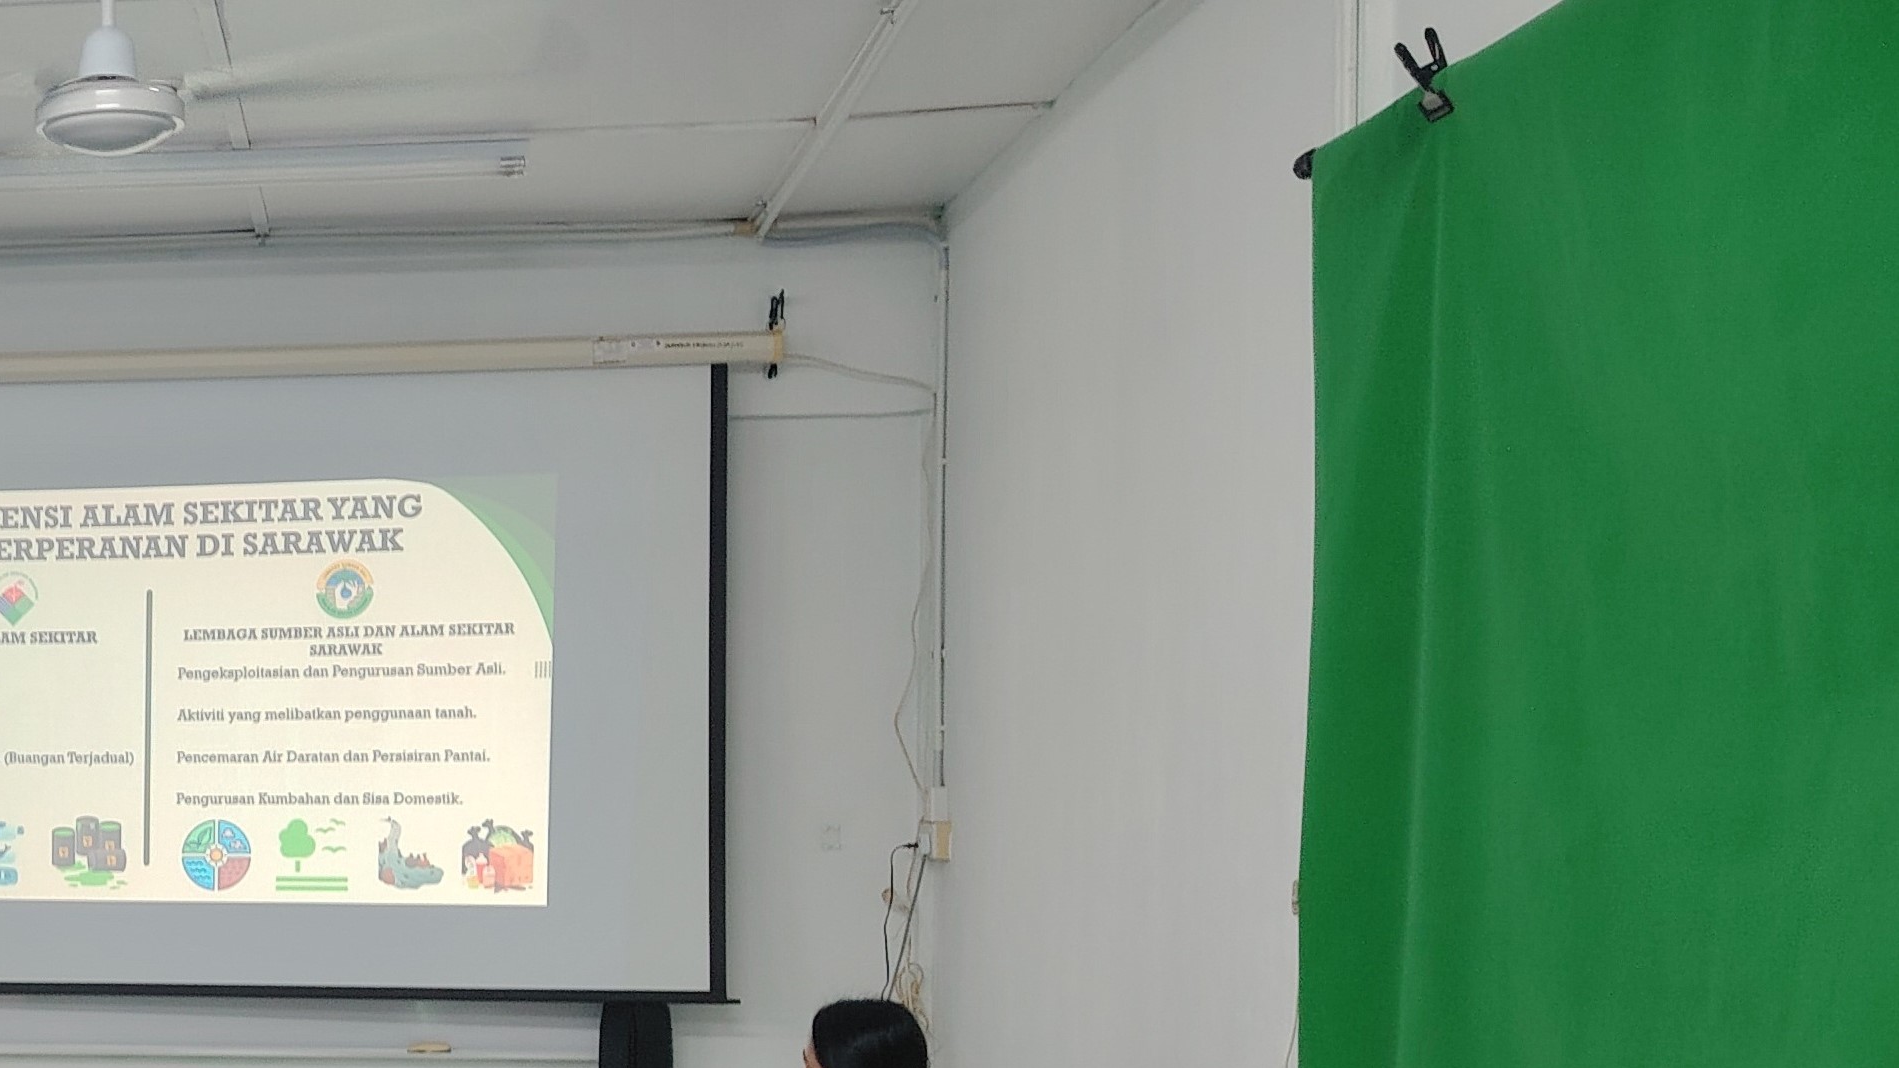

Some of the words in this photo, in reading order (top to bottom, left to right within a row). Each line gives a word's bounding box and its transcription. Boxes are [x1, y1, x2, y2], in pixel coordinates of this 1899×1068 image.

[79, 501, 175, 527] ALAM
[183, 497, 323, 525] SEKITAR
[327, 494, 422, 520] YANG
[197, 532, 234, 557] DI
[243, 527, 404, 555] SARAWAK
[29, 630, 98, 645] SEKITAR
[183, 628, 258, 641] LEMBAGA
[261, 626, 323, 640] SUMBER
[326, 625, 360, 639] ASLI
[363, 624, 396, 638] DAN
[399, 623, 444, 637] ALAM
[448, 622, 515, 636] SEKITAR
[309, 643, 383, 657] SARAWAK
[177, 665, 300, 682] Pengeksploitasian
[303, 665, 329, 678] dan
[332, 664, 413, 680] Pengurusan
[416, 662, 472, 676] Sumber
[475, 662, 506, 675] Asli.
[177, 708, 225, 722] Aktiviti
[228, 710, 261, 724] yang
[264, 707, 342, 721] melibatkan
[344, 708, 432, 722] penggunaan
[435, 706, 477, 719] tanah.
[4, 751, 65, 767] (Buangan
[67, 751, 135, 766] Terjadual)
[176, 750, 259, 763] Pencemaran
[262, 750, 283, 763] Air
[287, 749, 340, 762] Daratan
[343, 749, 369, 762] dan
[372, 749, 441, 762] Persisiran
[444, 749, 491, 762] Pantai.
[176, 792, 255, 808] Pengurusan
[258, 792, 330, 805] Kumbahan
[333, 792, 359, 805] dan
[362, 792, 390, 805] Sisa
[393, 792, 464, 805] Domestik.
